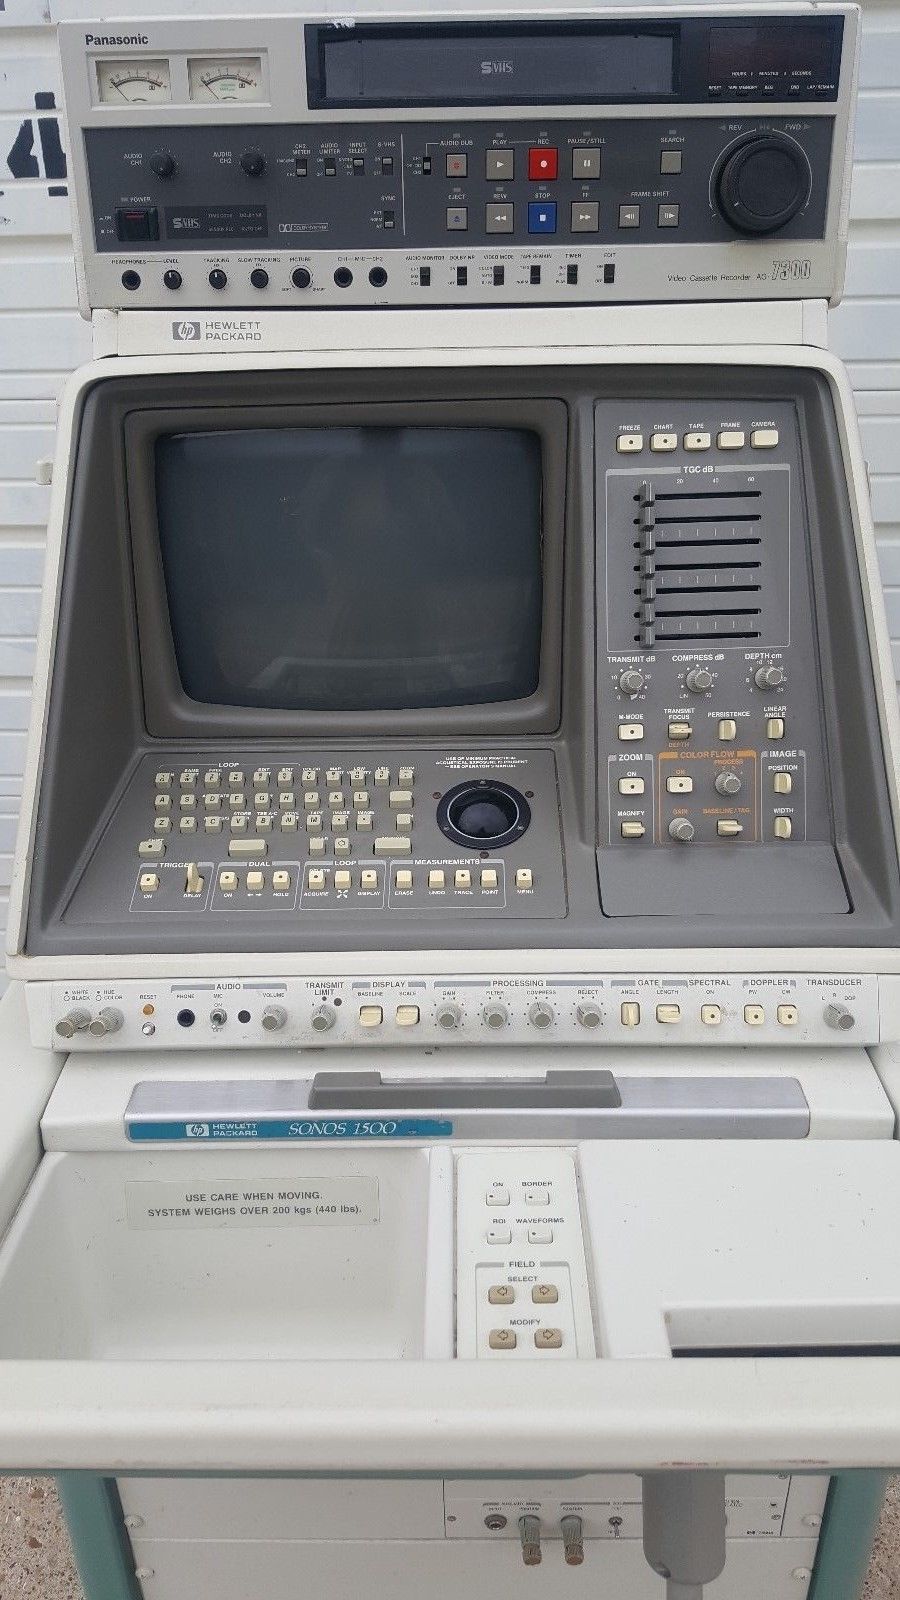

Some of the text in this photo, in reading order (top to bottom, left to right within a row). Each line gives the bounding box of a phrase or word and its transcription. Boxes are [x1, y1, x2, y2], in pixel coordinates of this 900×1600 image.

[85, 34, 150, 46] Panasonic
[206, 321, 261, 329] HEWLETT
[206, 332, 261, 340] PACKARD
[216, 983, 241, 991] AUDIO
[288, 1122, 396, 1136] SONOS 1500
[185, 1192, 322, 1202] USE CARE WHEN MOVING.
[148, 1205, 361, 1217] SYSTEM WEIGHS OVER 200 kgs (440 lbs).
